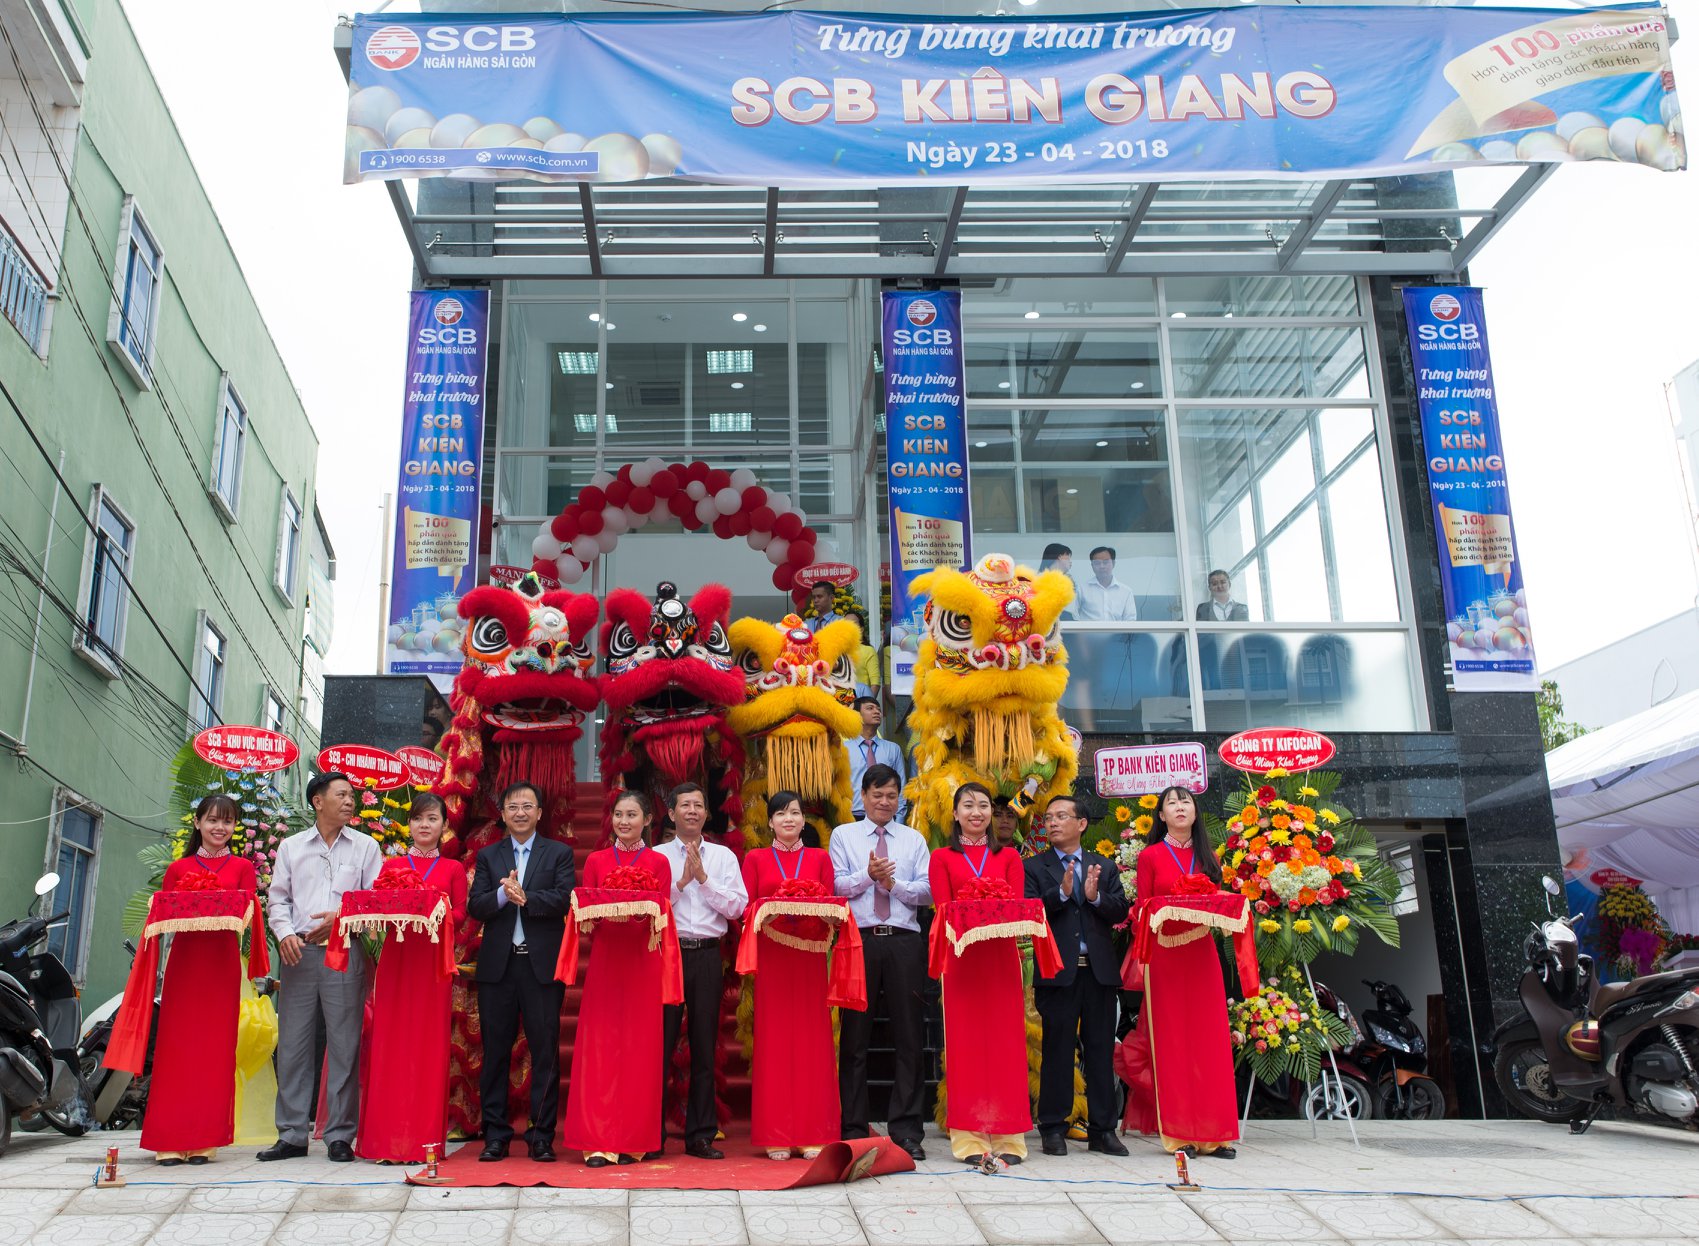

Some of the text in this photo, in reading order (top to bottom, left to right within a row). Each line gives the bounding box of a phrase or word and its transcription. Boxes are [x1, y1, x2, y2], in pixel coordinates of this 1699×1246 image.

[424, 26, 536, 51] SCB
[817, 22, 1236, 58] Tưng bừng khai trương
[1489, 30, 1561, 66] 100
[1563, 49, 1585, 60] các
[1585, 41, 1626, 55] Khách
[424, 53, 536, 69] NGÂN HÀNG SÀI GÒN
[1535, 71, 1562, 87] giao
[1563, 63, 1591, 76] dịch
[1617, 55, 1640, 66] tiên
[730, 66, 1337, 127] SCB KIÊN GIANG
[390, 155, 446, 164] 1900 6538
[496, 153, 588, 167] www.scb.com.vn
[906, 141, 978, 168] Ngày
[985, 142, 1018, 163] 23
[1041, 143, 1076, 162] 04
[1098, 139, 1169, 159] 2018
[418, 328, 477, 344] SCB
[892, 329, 953, 345] SCB
[1418, 323, 1479, 340] SCB
[412, 372, 443, 386] Tưng
[891, 373, 922, 387] Tưng
[1420, 368, 1453, 382] Tưng
[409, 390, 480, 405] khai trương
[888, 392, 960, 406] khai trương
[1420, 387, 1492, 399] khai trương
[422, 414, 463, 429] SCB
[904, 415, 946, 430] SCB
[1439, 409, 1482, 426] SCB
[418, 432, 464, 453] KIÊN
[903, 434, 949, 455] KIÊN
[1440, 430, 1487, 450] KIÊN
[405, 460, 476, 476] GIANG
[890, 461, 963, 478] GIANG
[1430, 454, 1503, 473] GIANG
[403, 485, 422, 493] Ngày
[891, 486, 911, 495] Ngày
[1432, 482, 1454, 490] Ngày
[1486, 480, 1506, 488] 2018
[425, 517, 449, 528] 100
[917, 519, 941, 530] 100
[1462, 514, 1486, 526] 100
[207, 733, 222, 747] SCB
[227, 735, 241, 749] KHU
[1231, 736, 1322, 753] CÔNG TY KIFOCAN
[328, 750, 341, 764] SCB
[345, 753, 356, 767] CHI
[388, 760, 402, 775] VINH
[1103, 750, 1199, 776] TP BANK KIÊN GIANG
